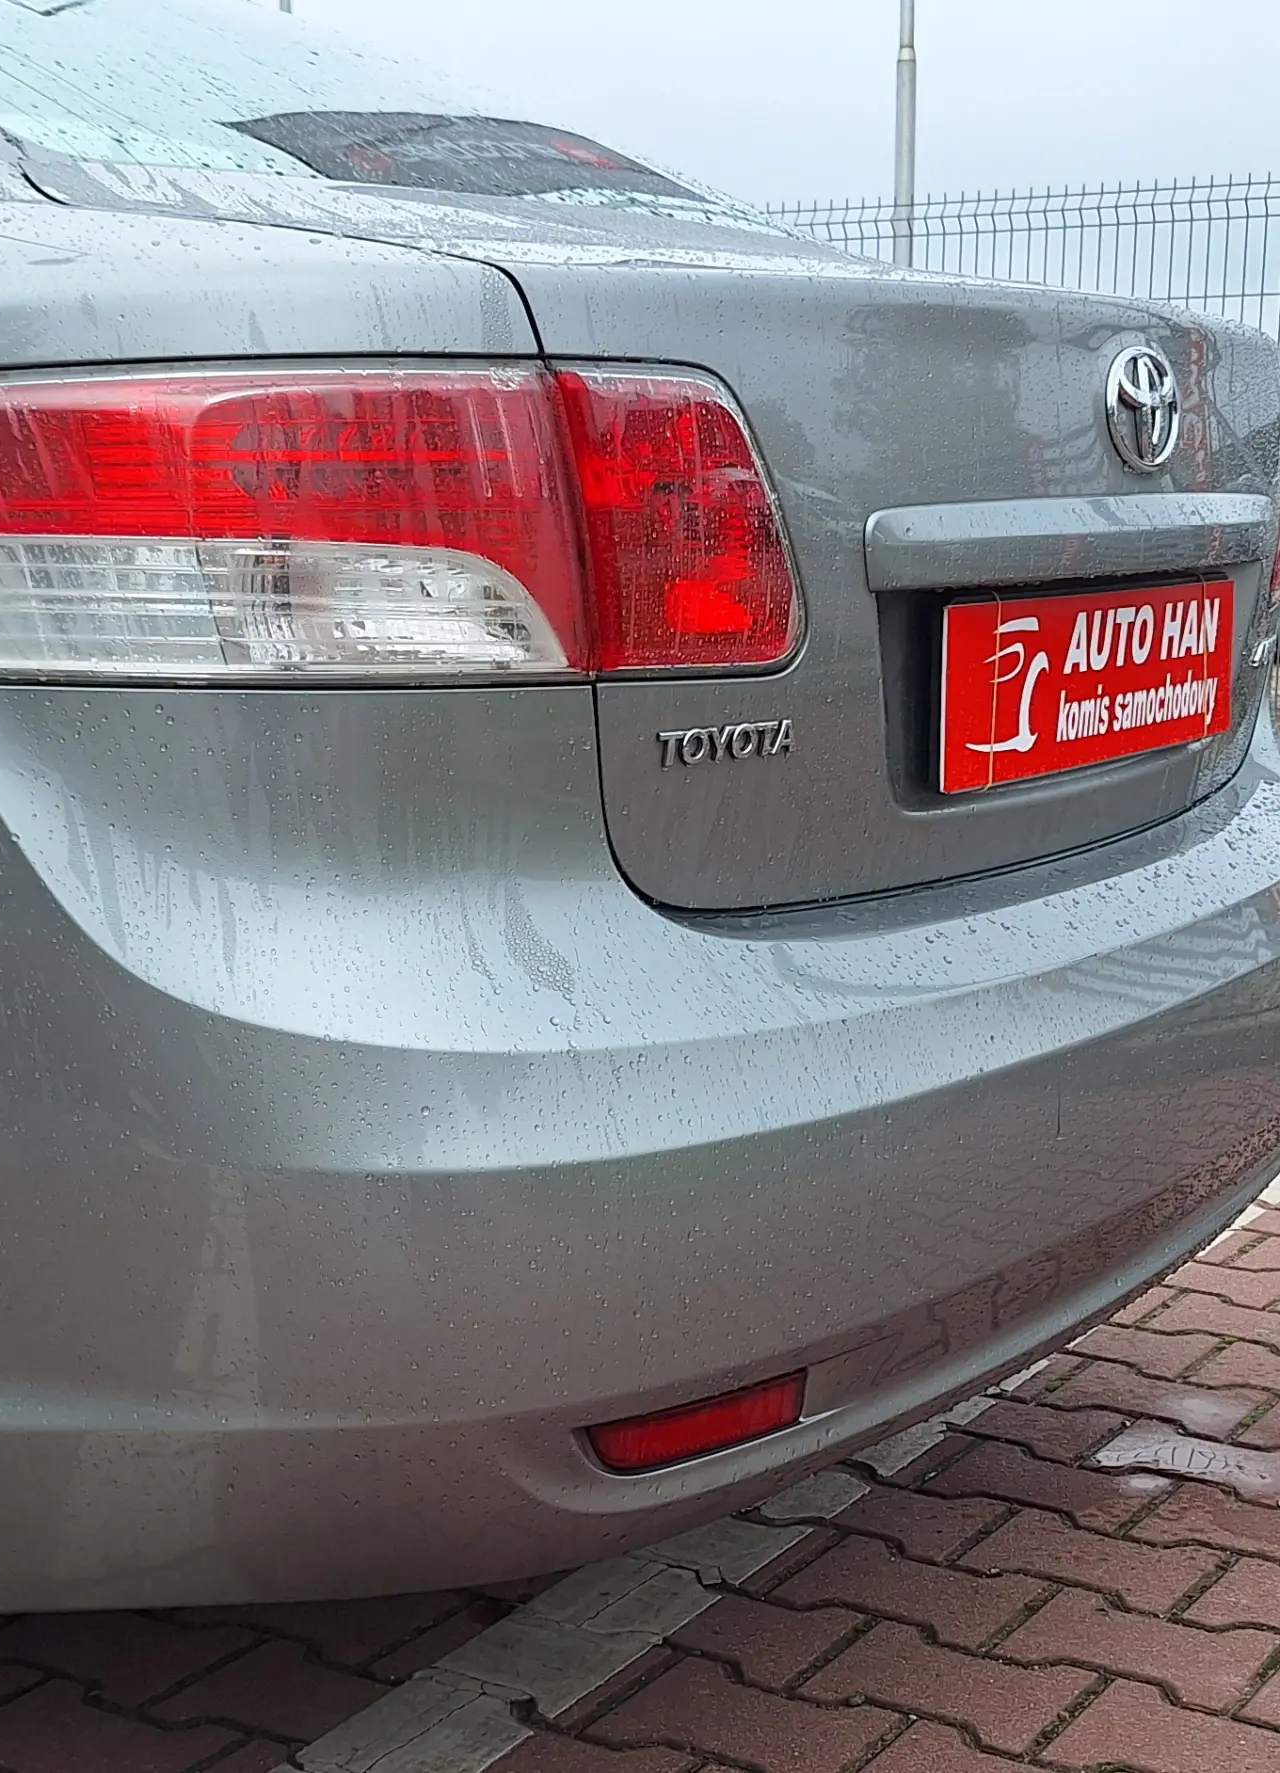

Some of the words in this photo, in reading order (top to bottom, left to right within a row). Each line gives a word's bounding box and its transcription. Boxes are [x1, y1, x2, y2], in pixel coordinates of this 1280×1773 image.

[1062, 603, 1155, 676] AUTO
[1159, 597, 1221, 661] HAN
[1055, 682, 1110, 743] komis
[1111, 668, 1219, 733] samochodowy
[657, 719, 796, 770] TOYOTA
